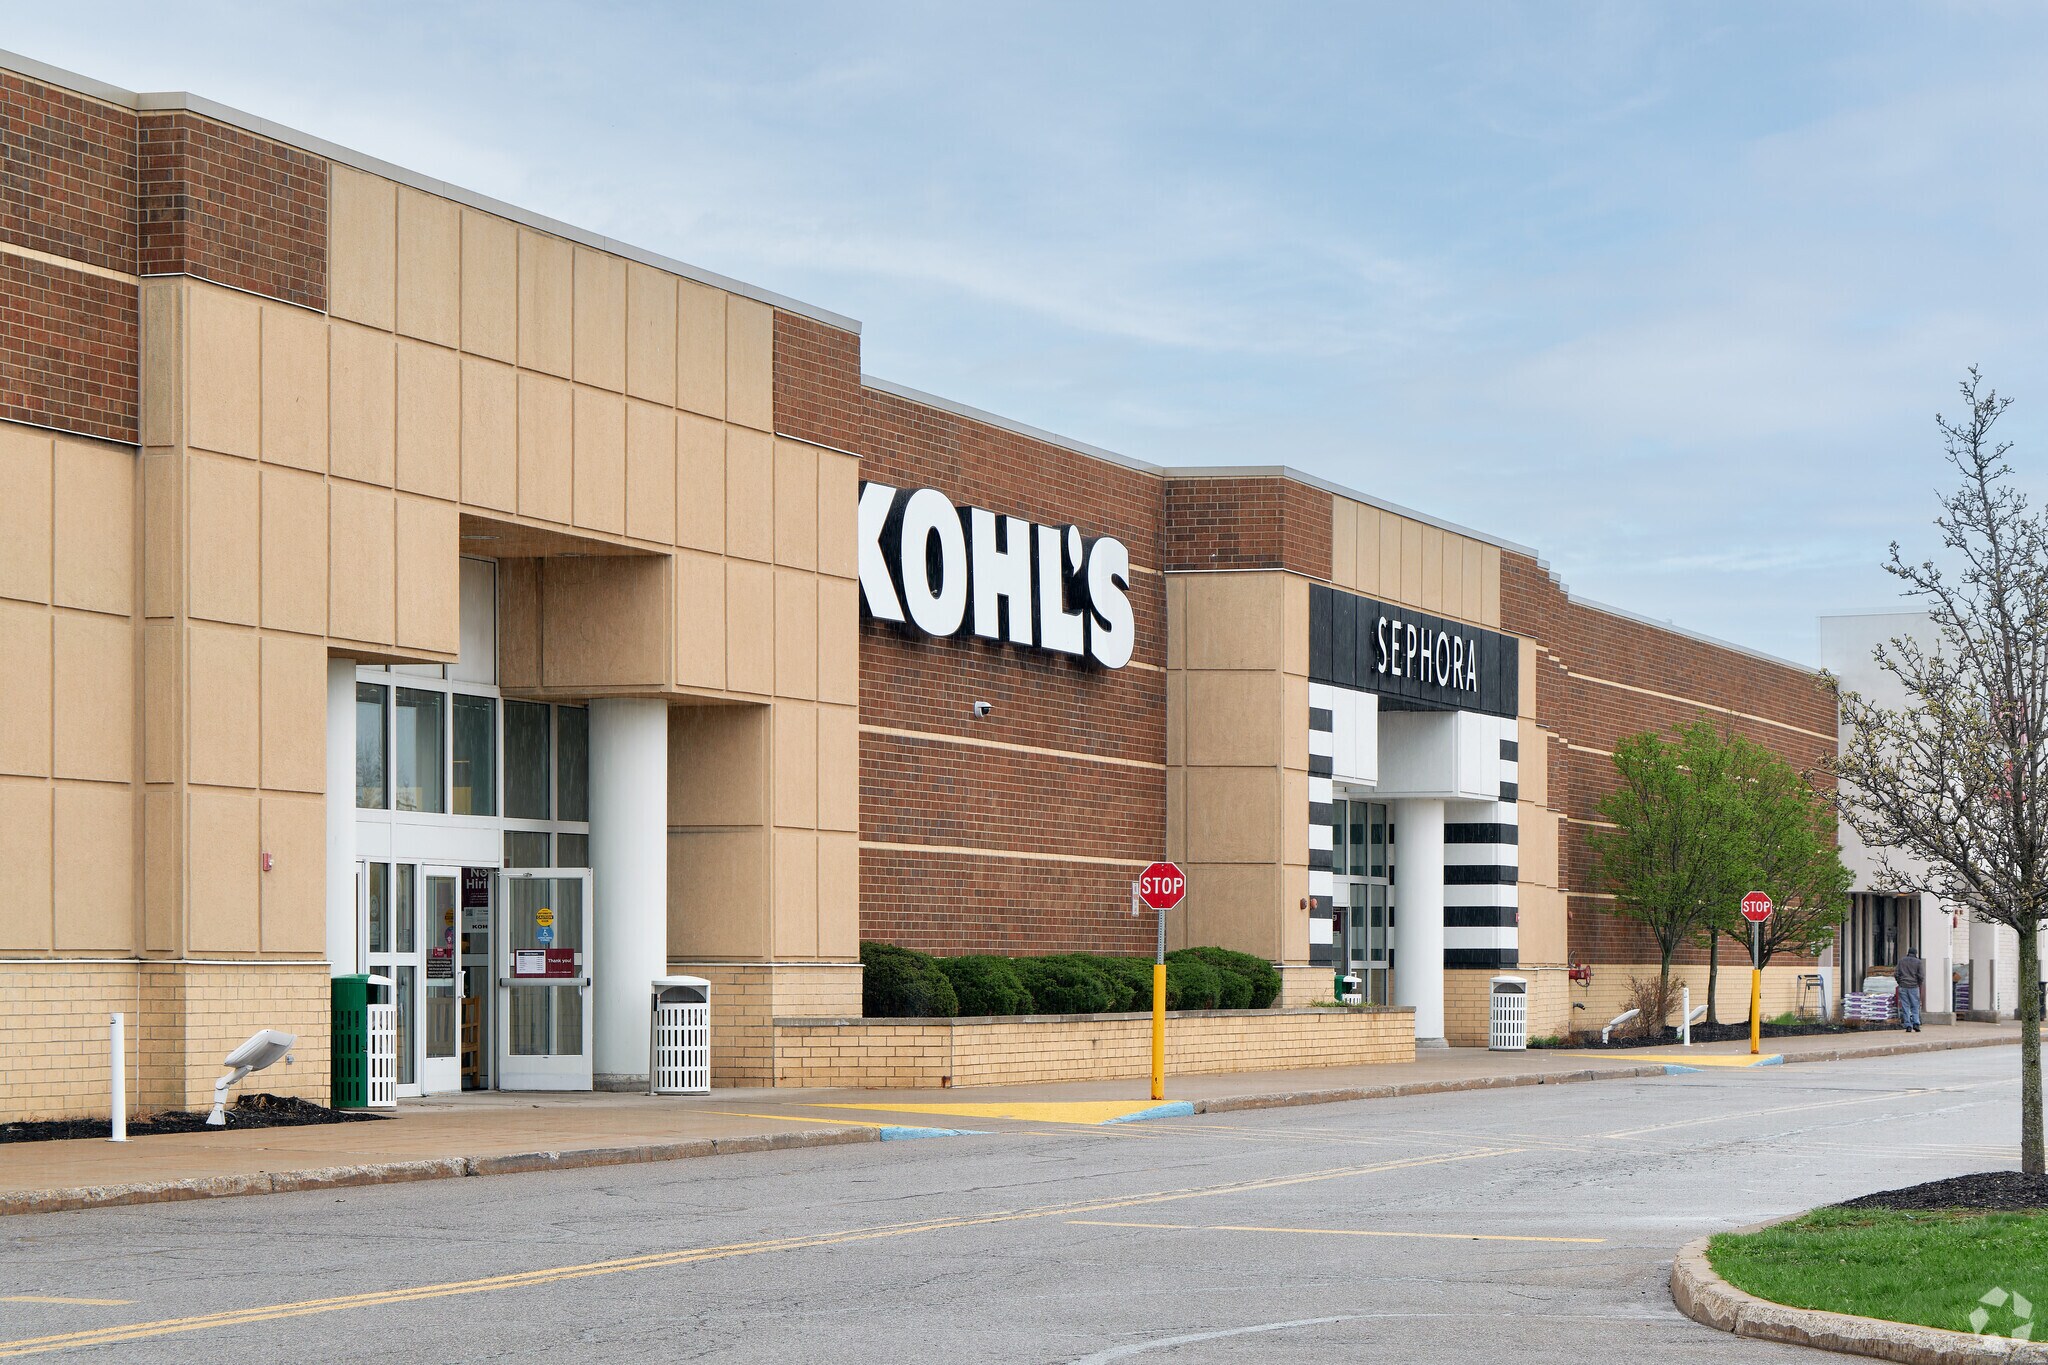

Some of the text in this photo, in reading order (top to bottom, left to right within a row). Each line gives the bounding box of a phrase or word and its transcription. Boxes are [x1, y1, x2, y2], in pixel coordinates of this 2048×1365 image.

[858, 482, 1135, 669] KOHL'S
[1377, 616, 1477, 692] SEPHORA
[471, 868, 488, 877] No
[466, 878, 488, 889] Hiri
[1141, 877, 1183, 895] STOP
[1743, 901, 1770, 912] STOP
